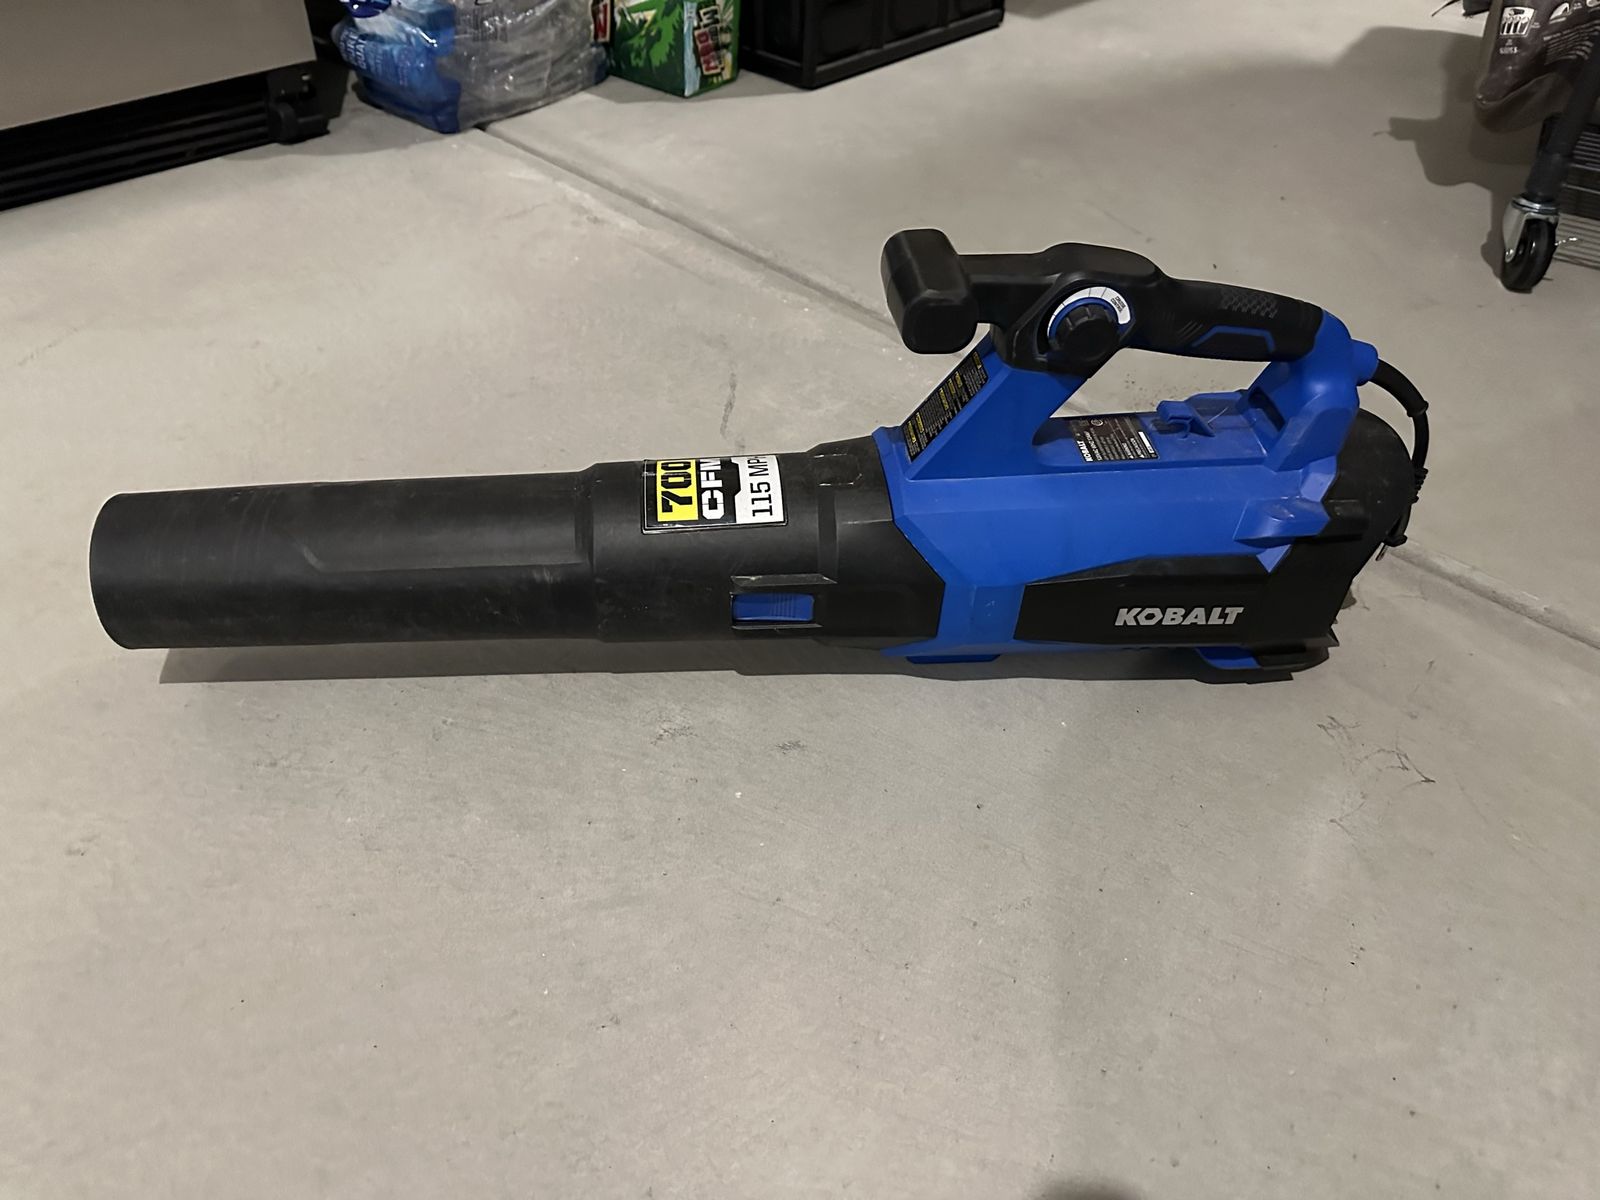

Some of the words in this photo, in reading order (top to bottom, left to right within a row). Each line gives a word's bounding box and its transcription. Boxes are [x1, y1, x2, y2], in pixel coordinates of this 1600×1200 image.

[661, 462, 692, 513] 700
[700, 459, 724, 519] CFM
[750, 482, 773, 517] 115
[1114, 607, 1244, 626] KOBALT
